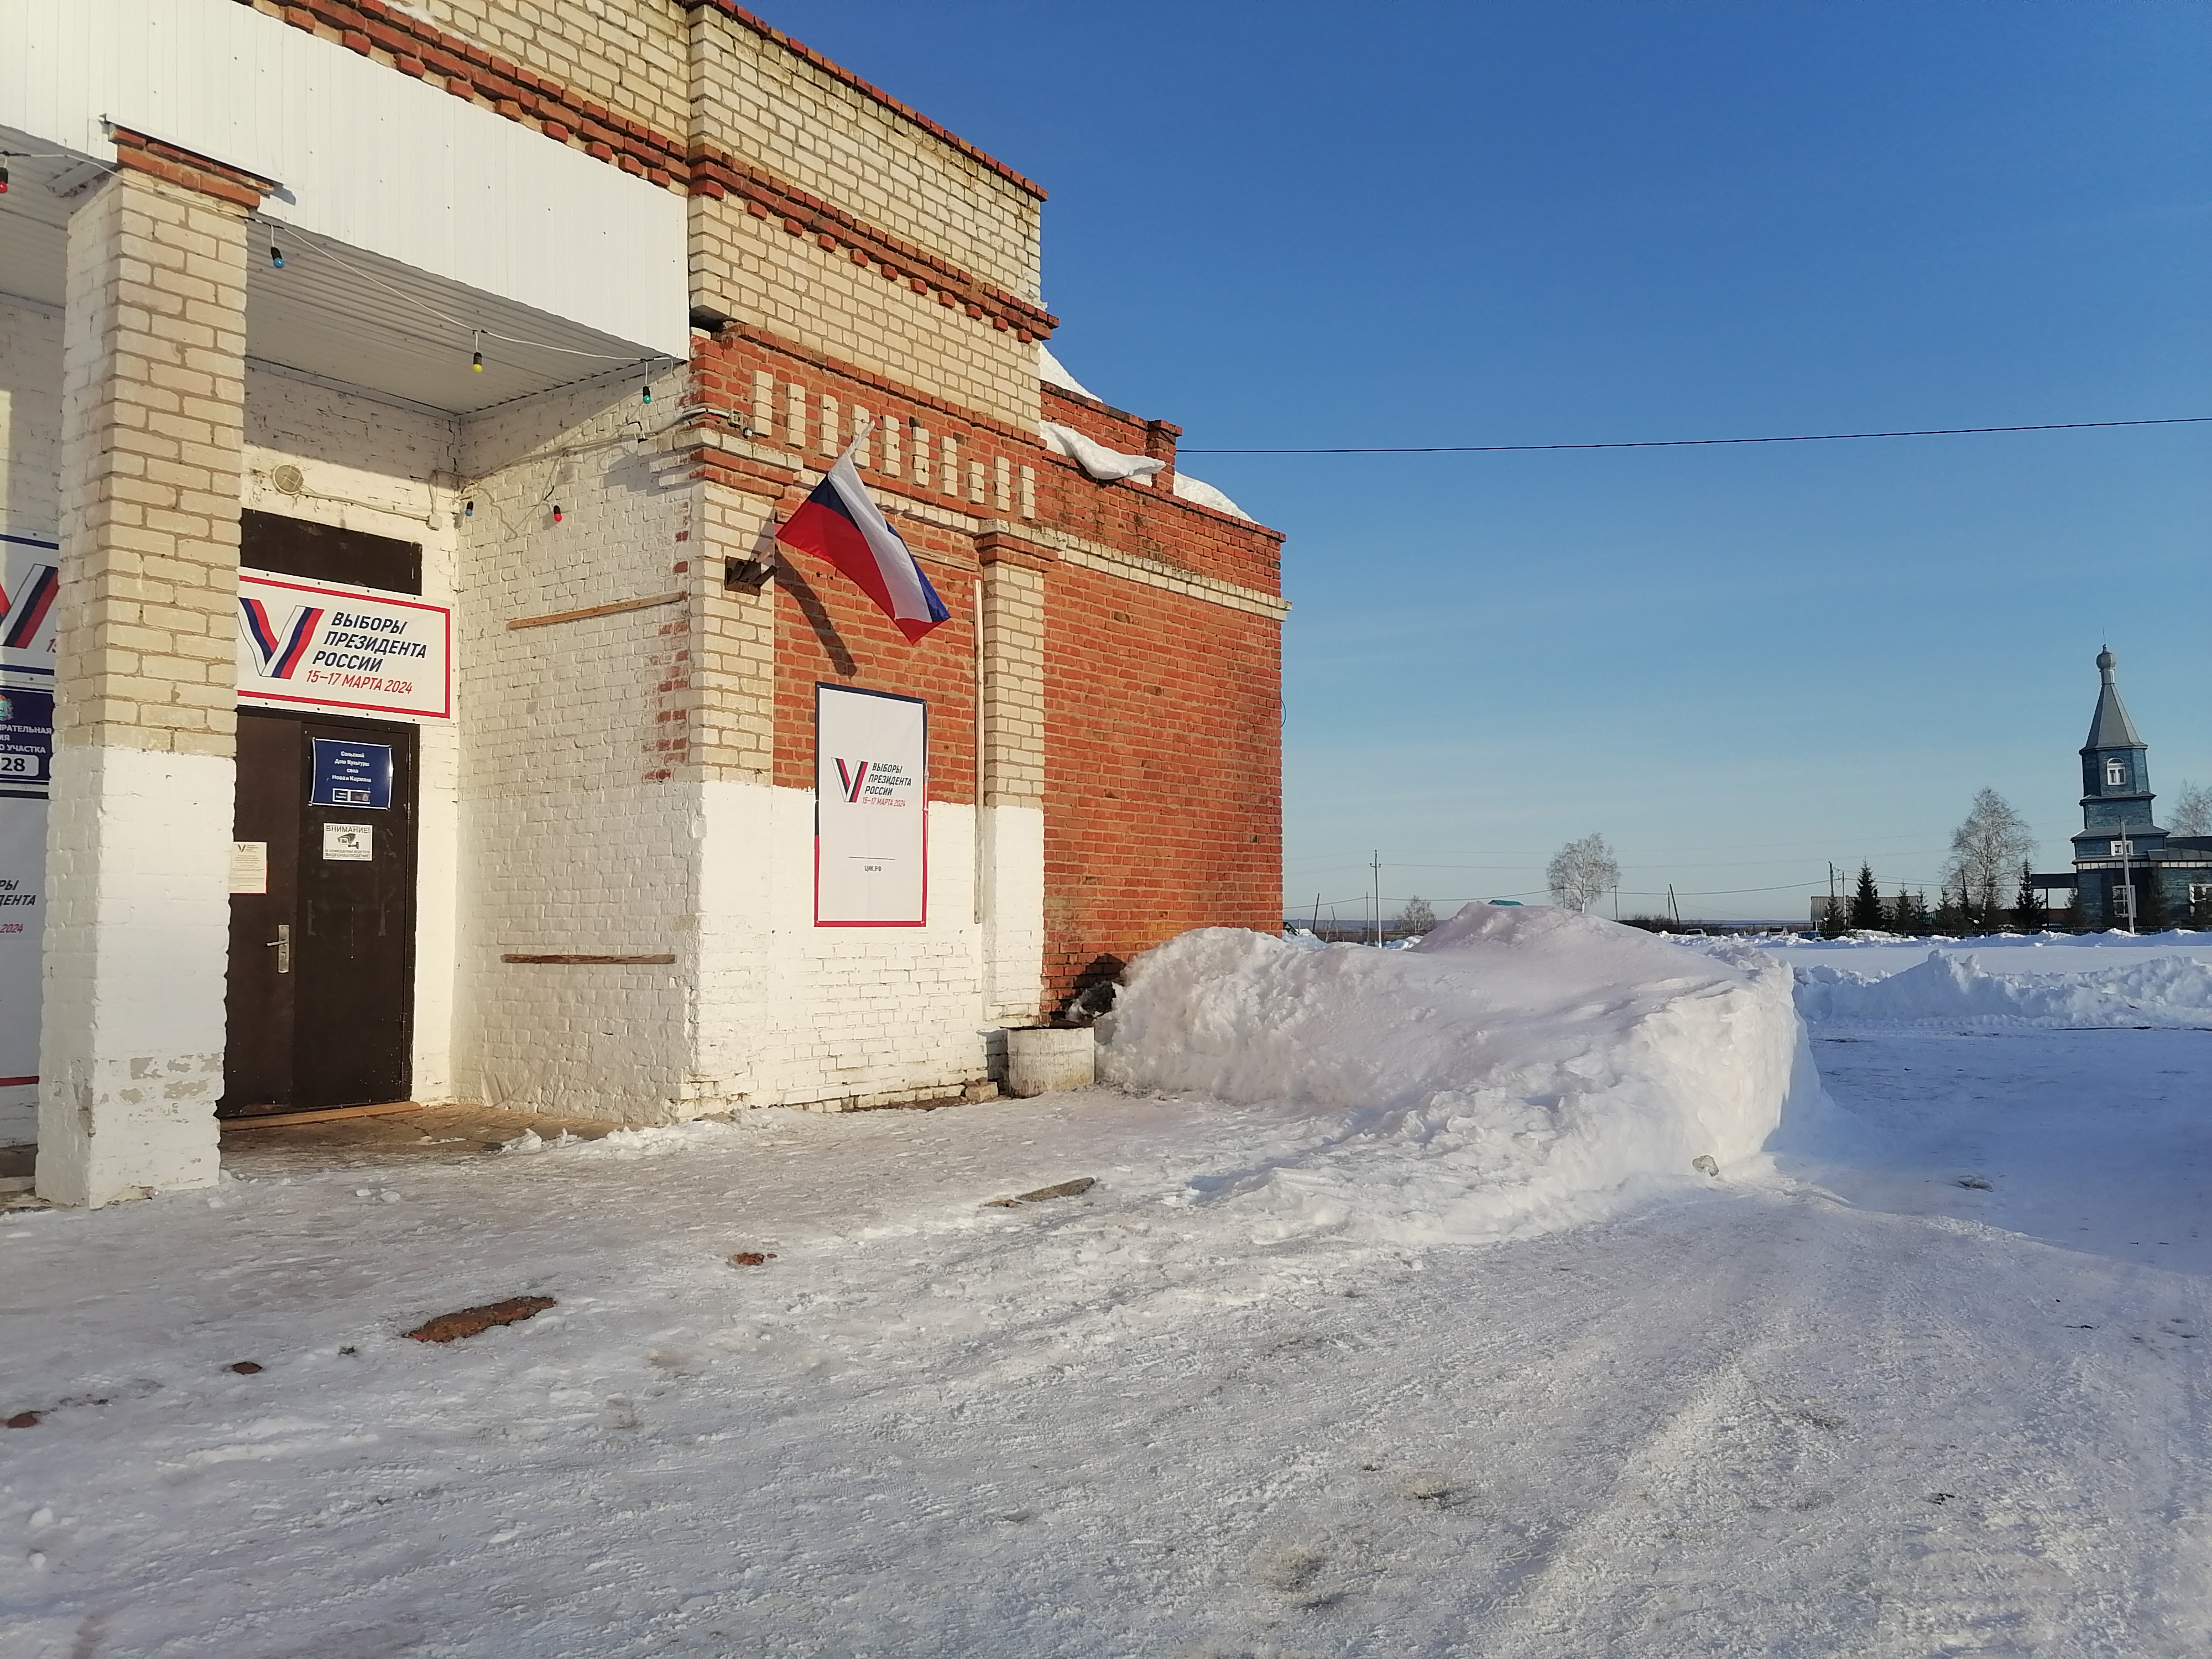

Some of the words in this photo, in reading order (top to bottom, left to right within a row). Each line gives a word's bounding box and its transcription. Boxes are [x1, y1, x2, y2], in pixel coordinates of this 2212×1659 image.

[331, 612, 408, 635] ВЫБОРЫ
[324, 631, 427, 659] ПРЕЗИДЕНТА
[312, 650, 384, 672] РОССИИ
[341, 674, 383, 690] МАРТА
[384, 680, 413, 694] 2024
[7, 744, 46, 754] УЧАСТКА
[1, 757, 25, 772] 28
[872, 763, 903, 774] ВЫБОРЫ
[868, 774, 912, 786] ПРЕЗИДЕНТА
[864, 785, 894, 796] РОССИИ
[877, 799, 893, 807] МАРТА
[893, 799, 906, 807] 2024
[326, 825, 370, 833] ВНИМАНИЕ!
[0, 924, 24, 933] 2024
